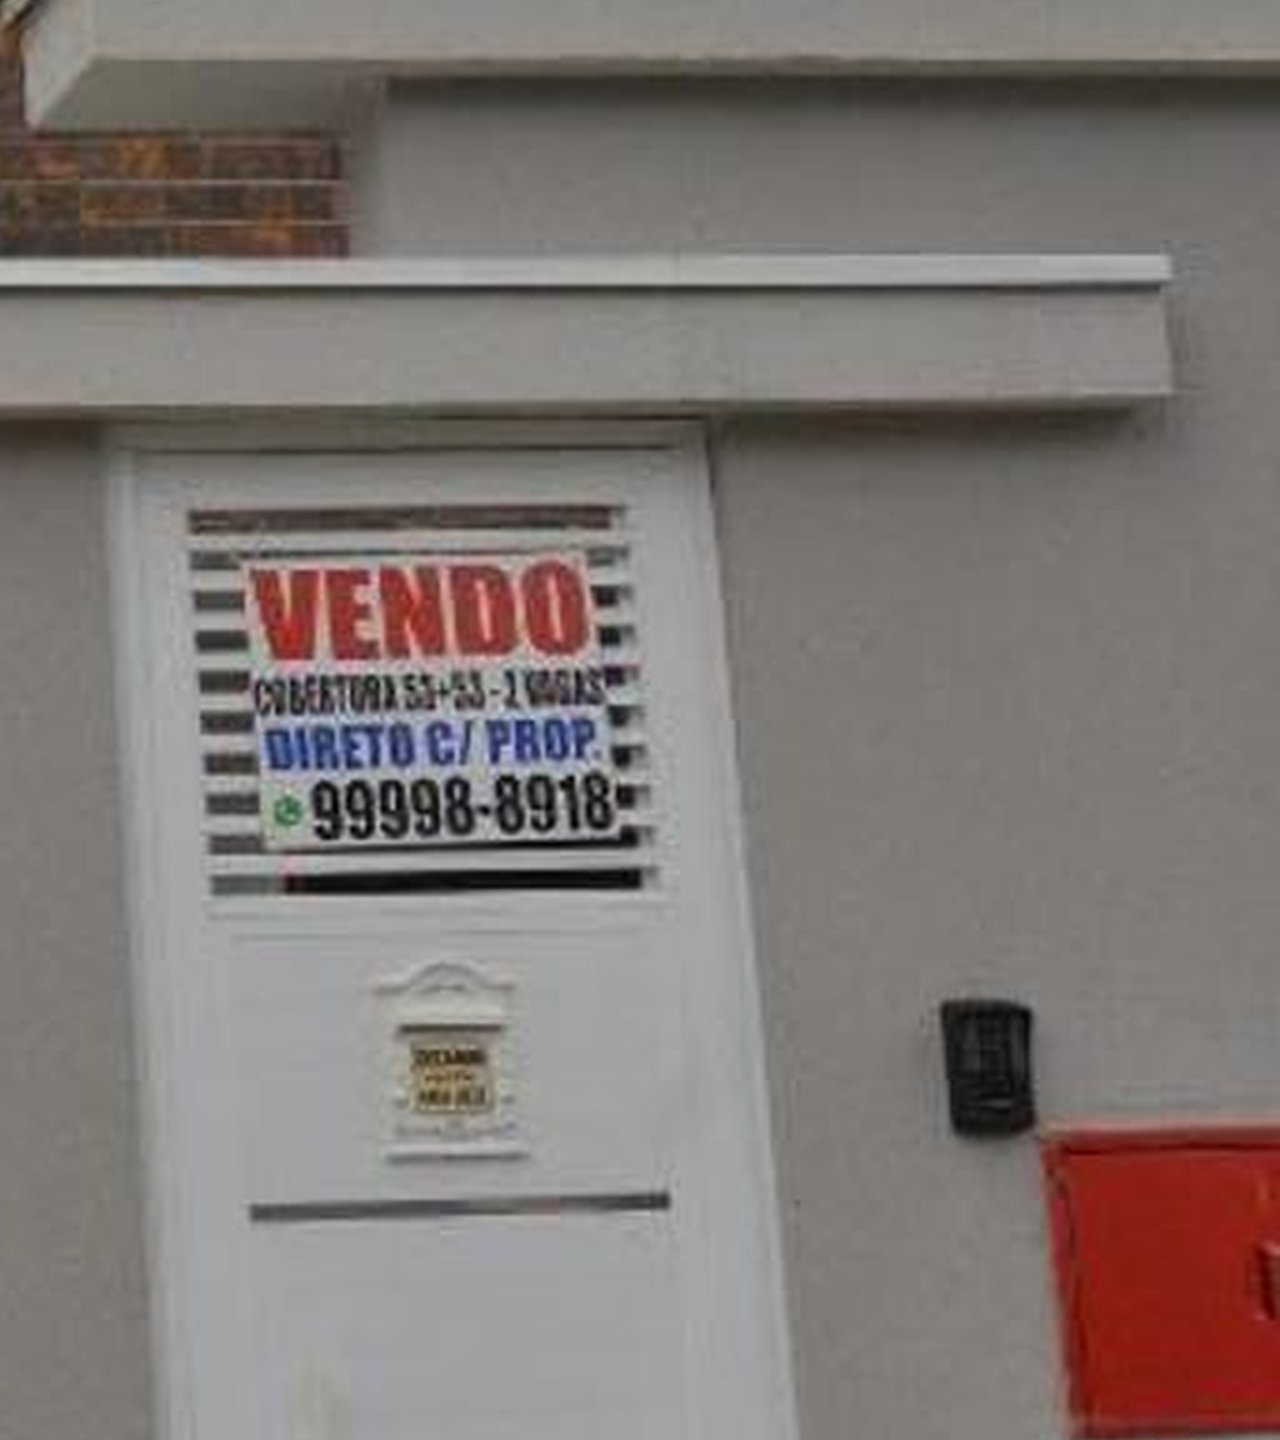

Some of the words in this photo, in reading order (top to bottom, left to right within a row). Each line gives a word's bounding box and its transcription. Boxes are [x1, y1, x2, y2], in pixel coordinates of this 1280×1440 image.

[250, 558, 590, 661] VENDO
[254, 674, 399, 717] COBERTURA
[264, 722, 416, 771] DIRETO
[427, 720, 472, 766] C/
[485, 718, 603, 765] PROP.
[312, 772, 616, 841] 99998-8918
